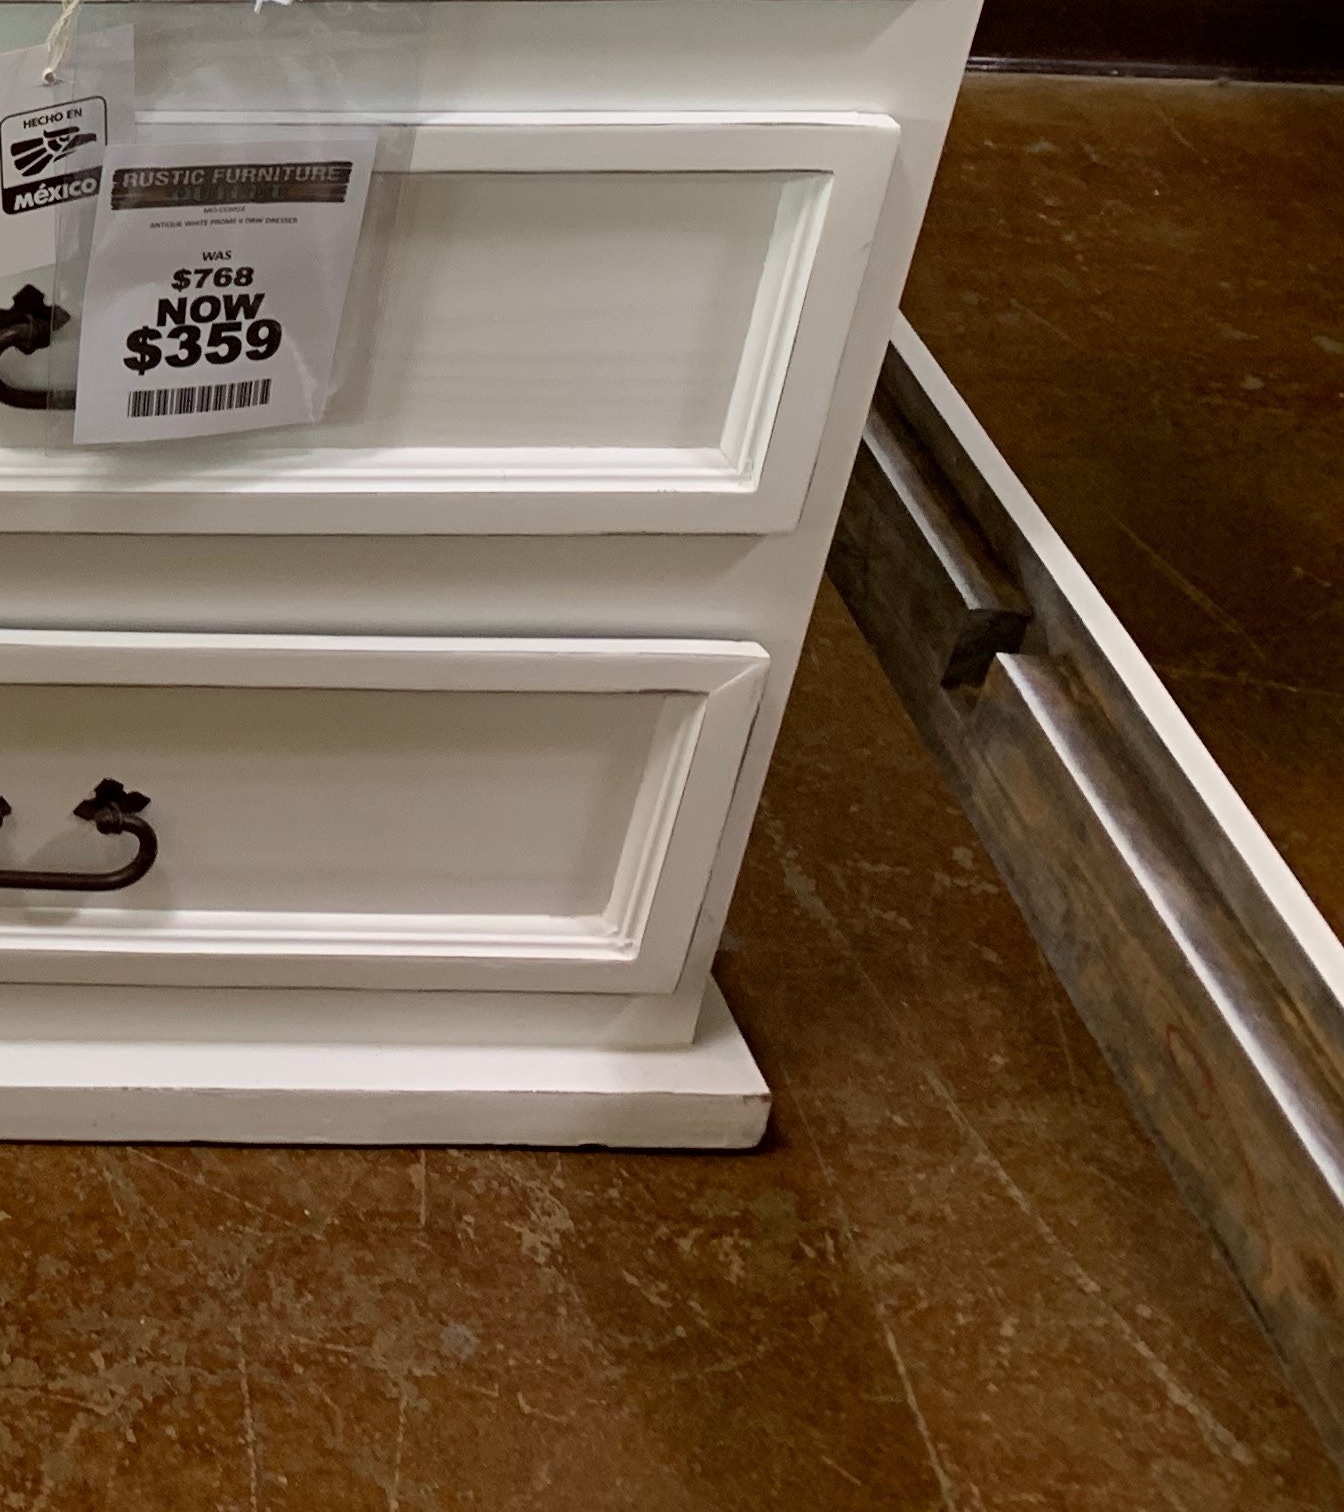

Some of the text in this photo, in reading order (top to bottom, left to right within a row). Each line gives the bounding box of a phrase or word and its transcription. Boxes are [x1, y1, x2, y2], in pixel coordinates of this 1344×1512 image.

[23, 108, 83, 129] HECHO EN
[122, 165, 341, 188] RUSTIC FURNITURE
[202, 250, 233, 262] WAS
[171, 266, 254, 292] $768
[156, 293, 265, 327] NOW
[123, 318, 283, 376] $359
